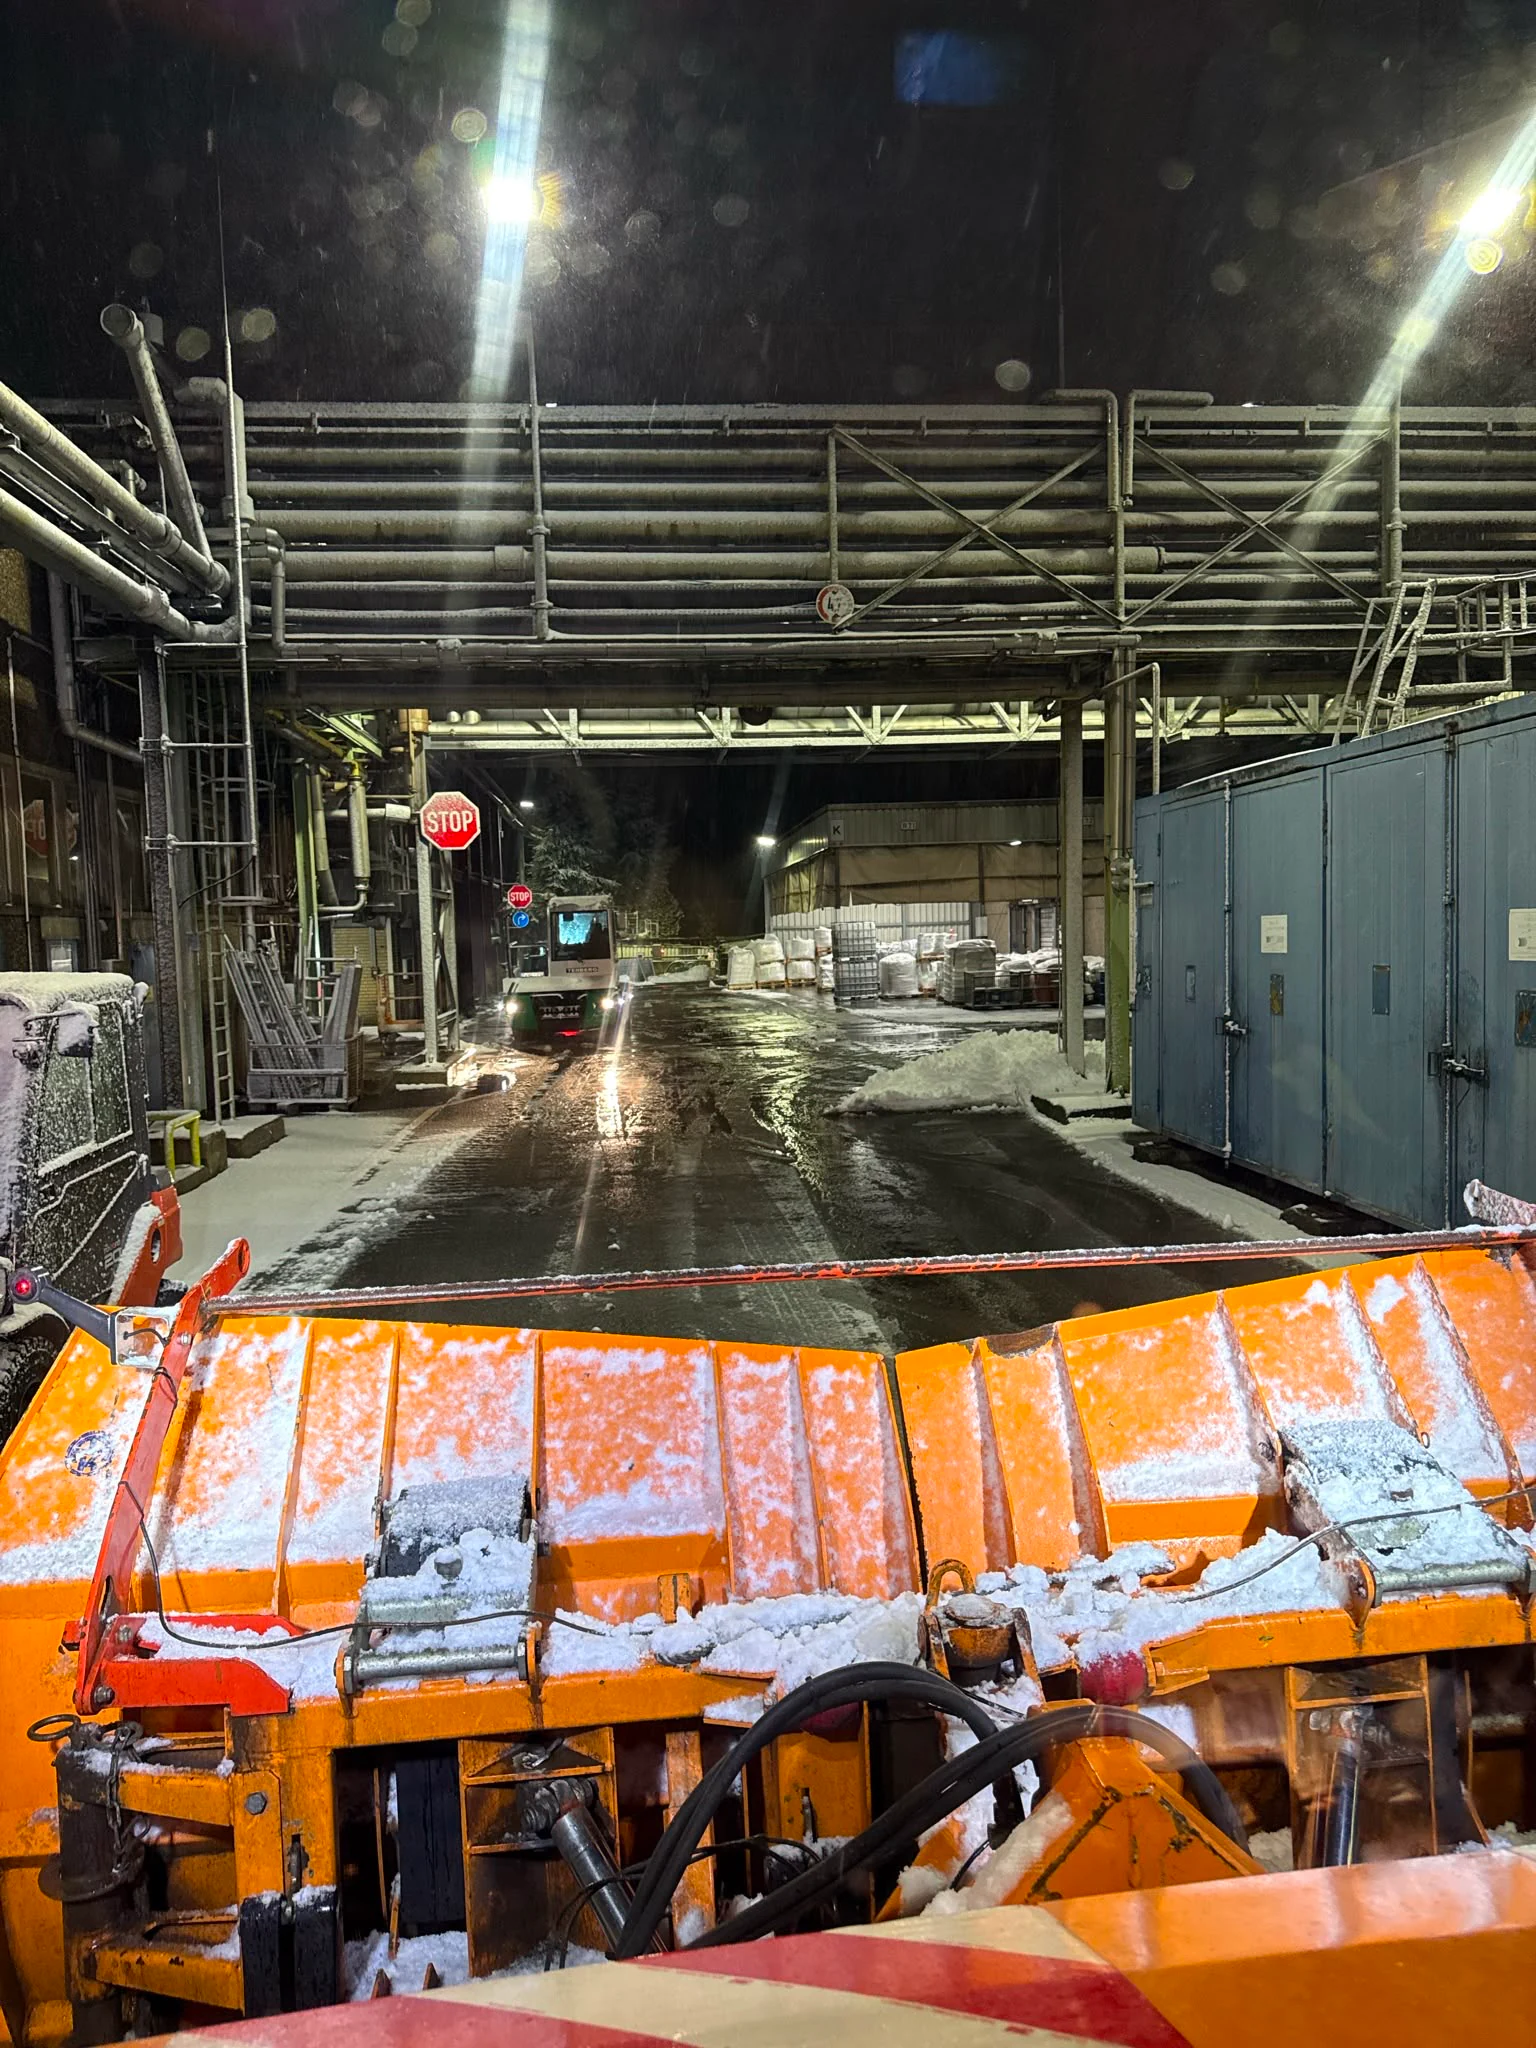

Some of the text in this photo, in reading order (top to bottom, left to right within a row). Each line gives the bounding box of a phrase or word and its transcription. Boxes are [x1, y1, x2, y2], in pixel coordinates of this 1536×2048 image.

[427, 810, 473, 833] STOP
[832, 825, 841, 835] K
[510, 891, 530, 902] STOP
